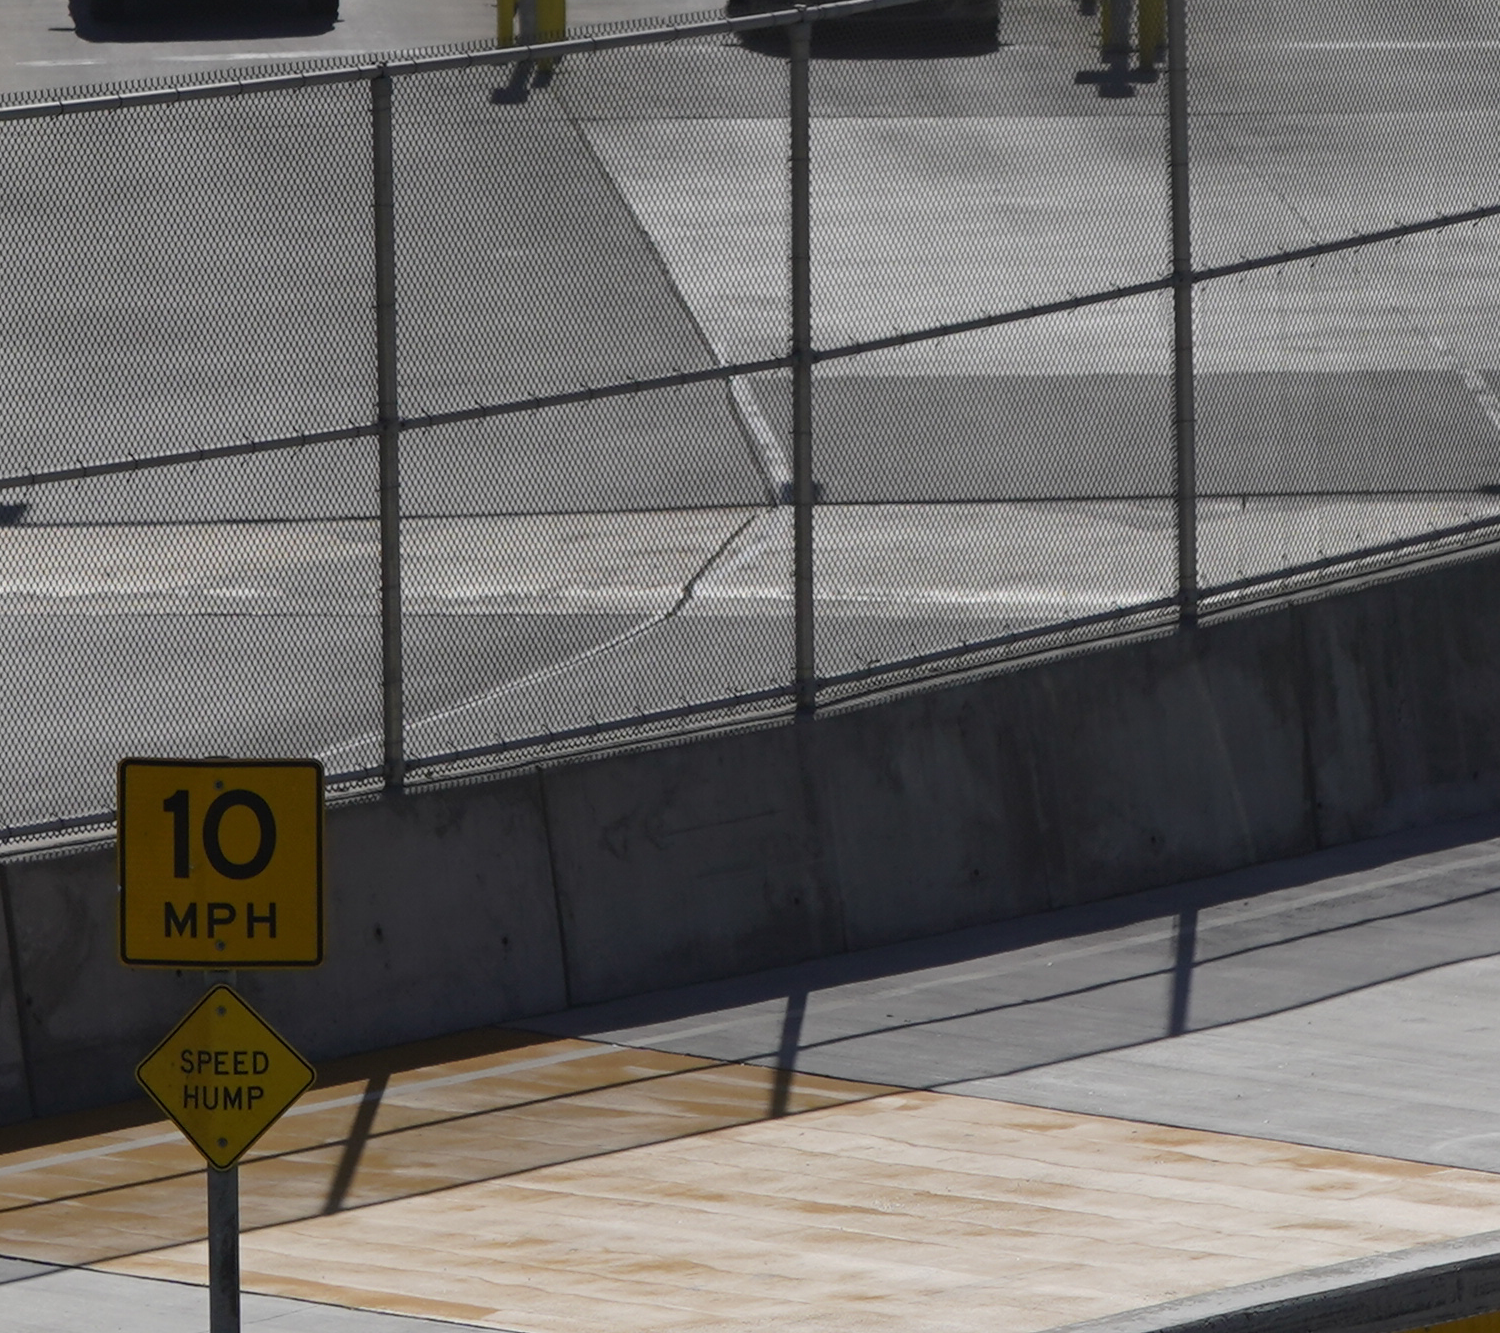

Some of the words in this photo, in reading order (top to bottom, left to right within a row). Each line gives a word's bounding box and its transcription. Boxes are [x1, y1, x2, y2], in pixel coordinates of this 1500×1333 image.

[163, 789, 277, 880] 10
[164, 901, 277, 939] MPH
[180, 1049, 269, 1075] SPEED
[184, 1085, 264, 1110] HUMP
